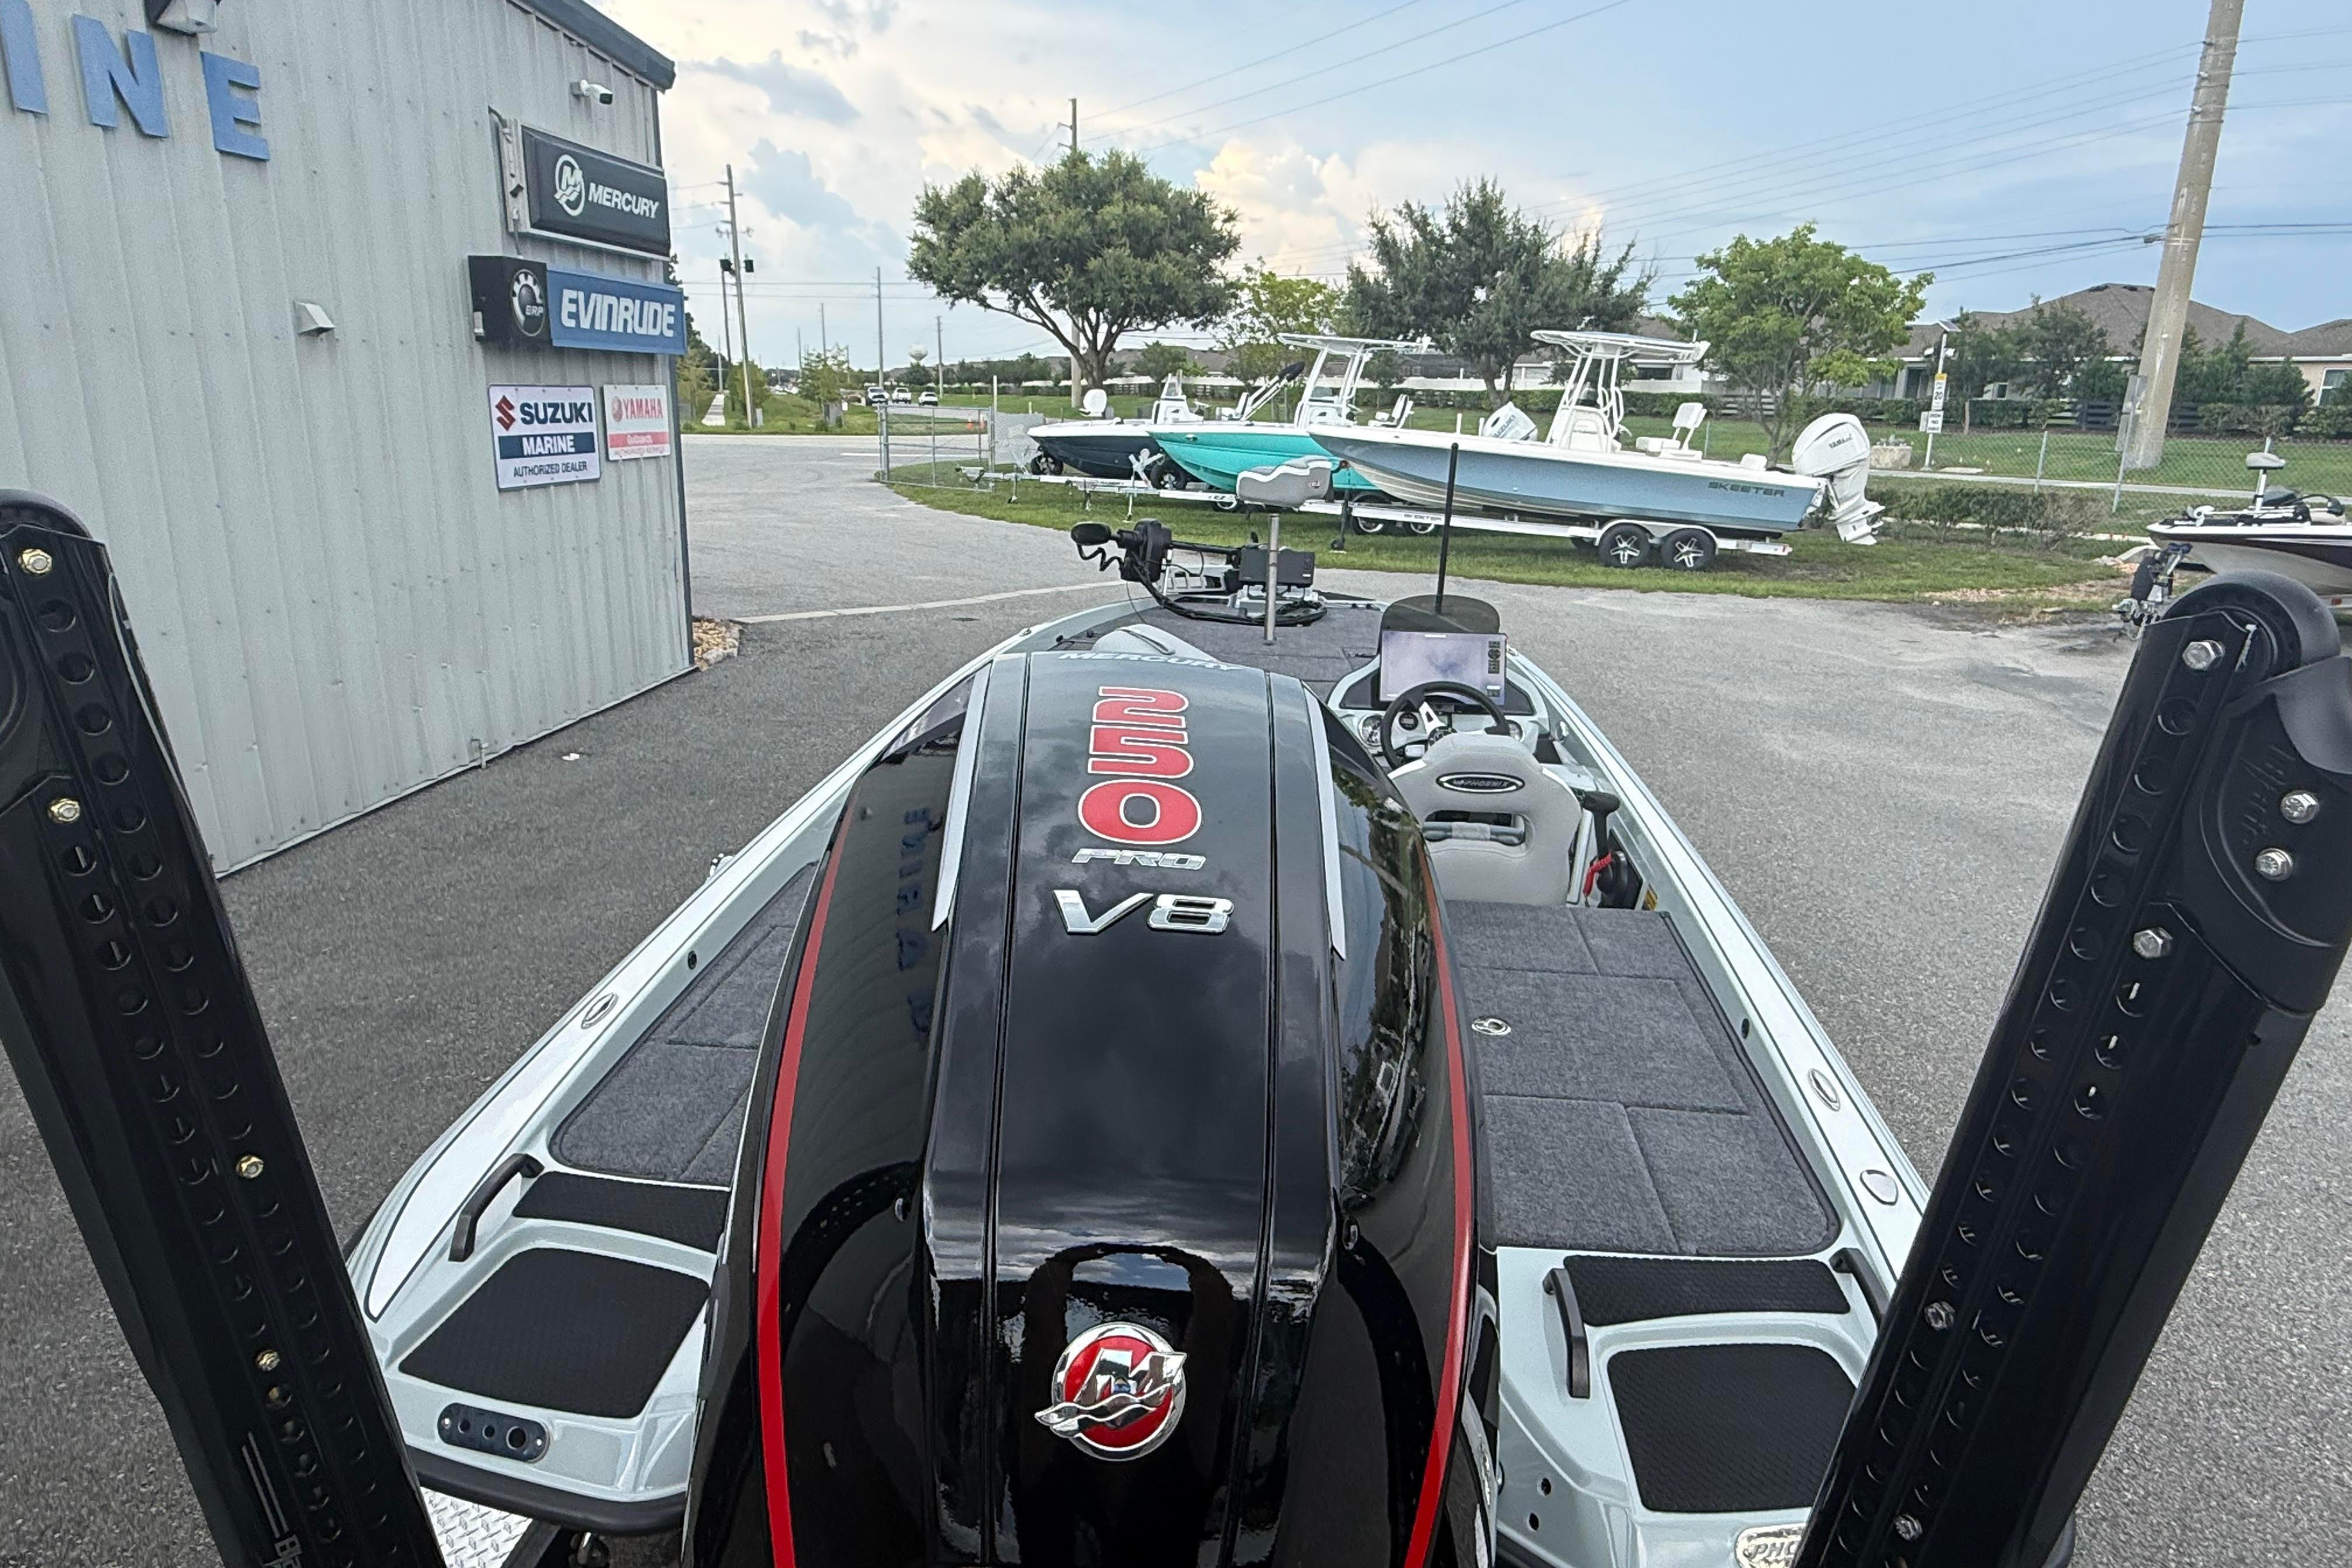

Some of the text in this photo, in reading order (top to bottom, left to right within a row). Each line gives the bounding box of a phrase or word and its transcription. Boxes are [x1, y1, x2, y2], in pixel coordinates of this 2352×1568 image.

[588, 183, 660, 219] MERCURY
[562, 289, 675, 337] EVINRUDE
[519, 402, 593, 425] SUZUKI
[623, 398, 663, 419] YAMAHA
[522, 435, 576, 456] MARINE
[513, 461, 587, 477] AUTHORIZED DEALER
[1058, 653, 1247, 671] MERCURY
[1077, 685, 1203, 846] 250
[1071, 848, 1207, 870] PRO
[1052, 889, 1236, 935] V8
